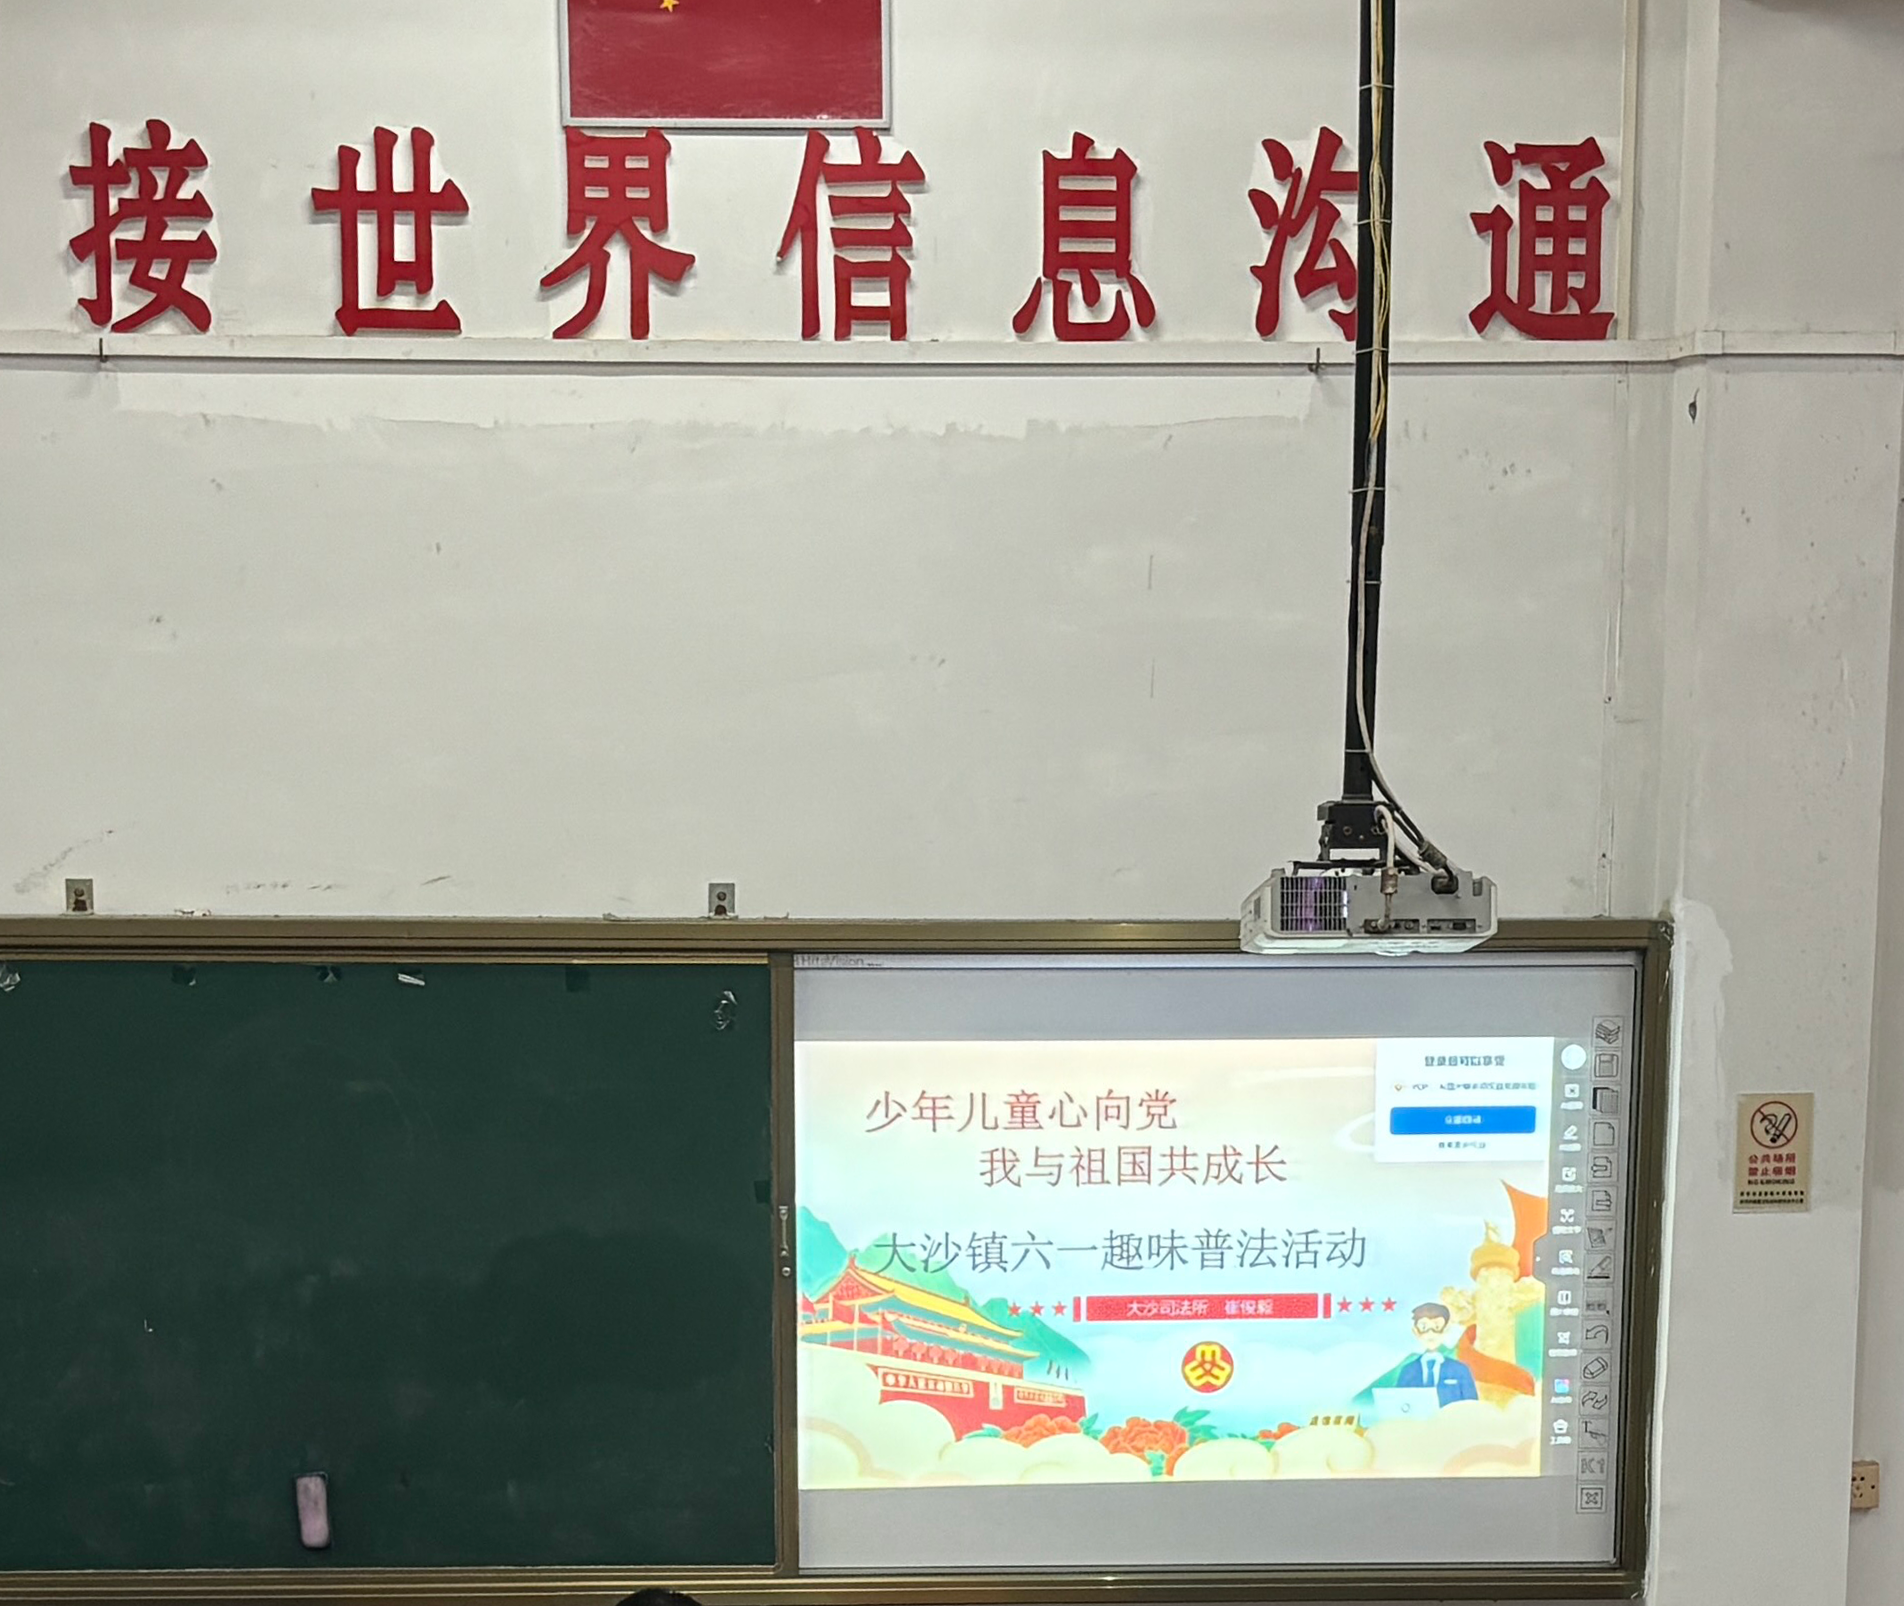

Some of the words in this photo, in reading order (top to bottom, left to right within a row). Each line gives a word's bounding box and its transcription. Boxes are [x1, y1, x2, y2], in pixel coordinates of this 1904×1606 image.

[864, 1088, 1179, 1133] 少年儿童心向党
[979, 1143, 1289, 1188] 我与祖国共成长
[873, 1227, 1367, 1274] 大沙镇六一趣味普法活动
[1126, 1299, 1209, 1317] 大沙司法所
